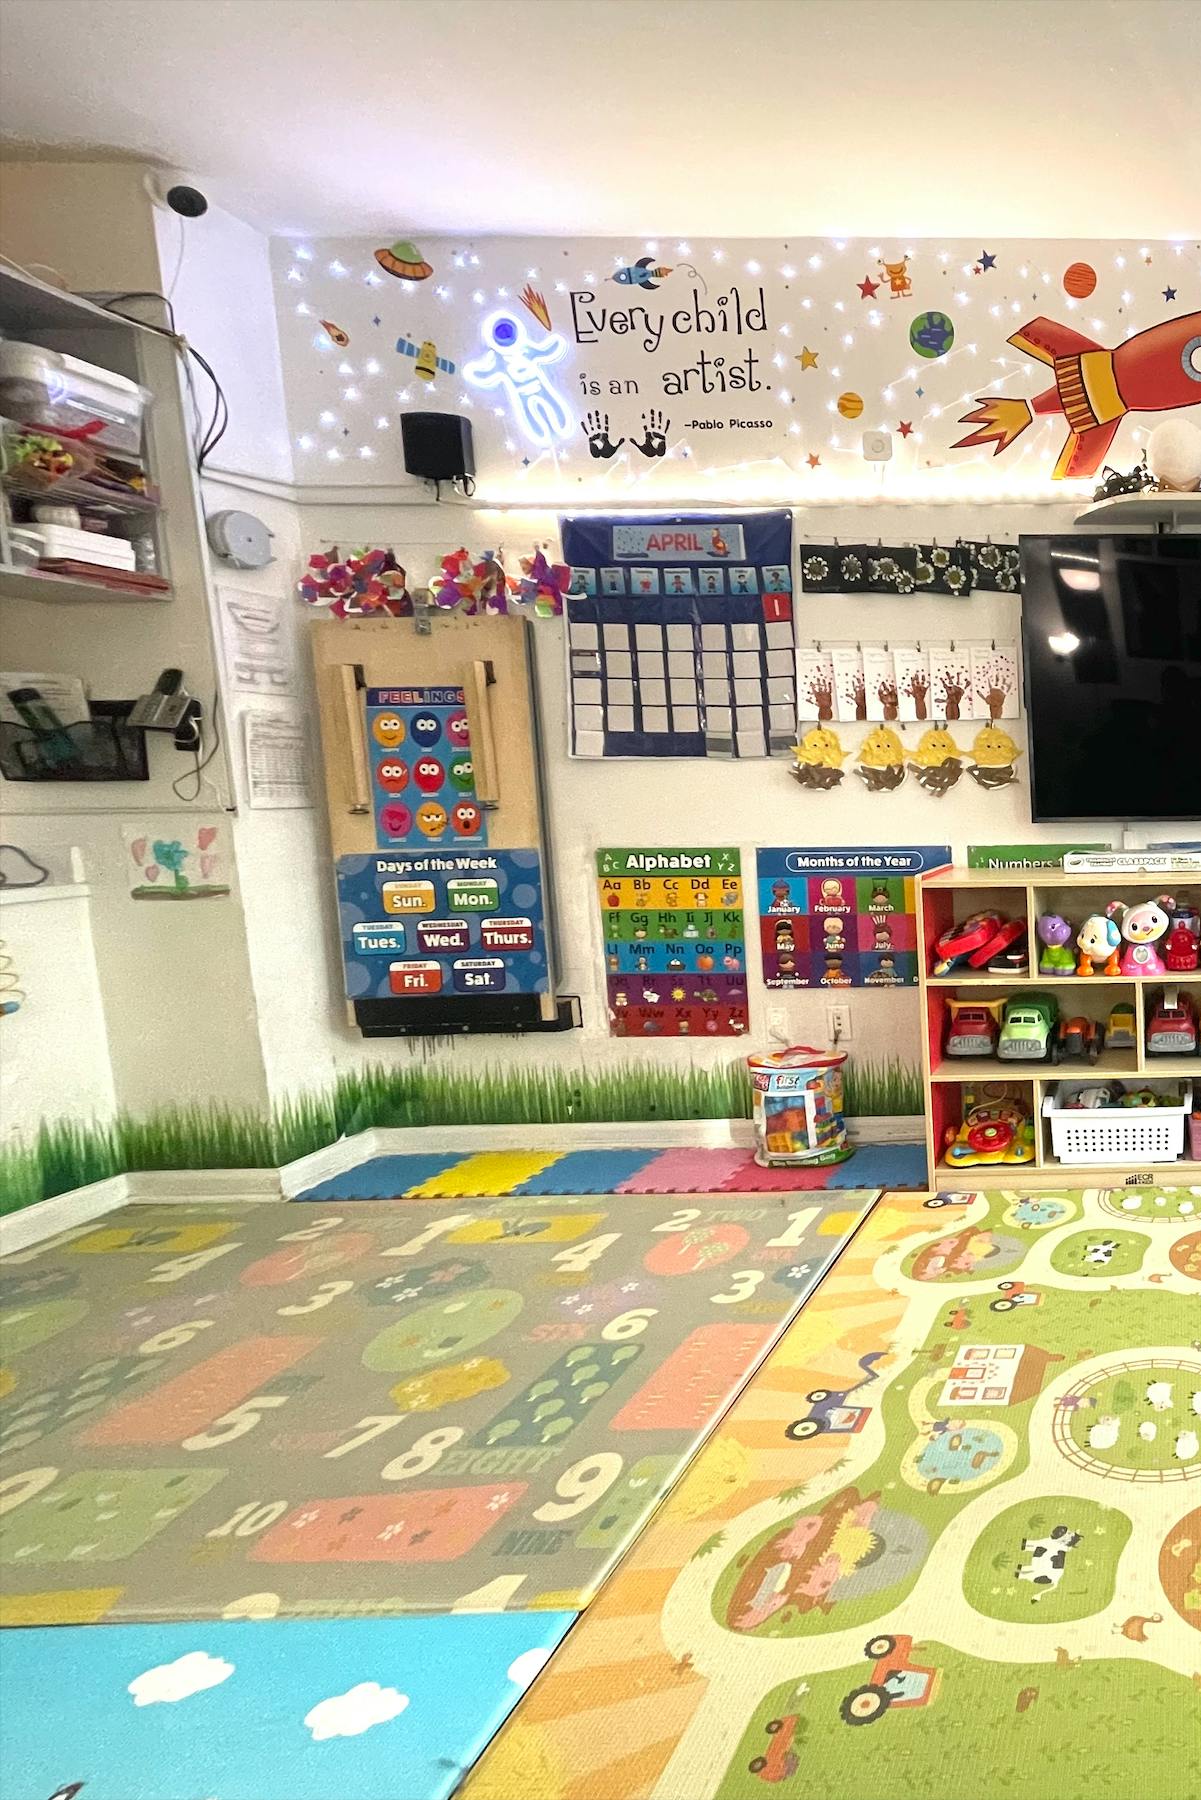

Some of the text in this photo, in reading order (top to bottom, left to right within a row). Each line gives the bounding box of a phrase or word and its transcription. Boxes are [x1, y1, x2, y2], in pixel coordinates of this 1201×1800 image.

[570, 287, 768, 352] Every child
[579, 348, 771, 396] is an artist.
[729, 419, 773, 429] Picasso
[646, 533, 704, 551] APRIL
[378, 690, 465, 704] FEELINGS
[604, 853, 612, 862] A
[626, 854, 712, 872] Alphabet
[722, 853, 729, 861] X
[797, 856, 912, 868] Months of the Year
[988, 857, 1053, 869] Numbers
[376, 857, 497, 874] Days of the Week
[612, 861, 620, 870] C
[603, 878, 738, 890] Aa Bb Cc Dd Ee
[392, 895, 427, 908] Sun.
[453, 893, 494, 906] Mon.
[767, 905, 801, 914] January
[814, 905, 851, 914] February
[608, 912, 621, 923] Ff
[630, 912, 649, 926] Gg
[658, 912, 677, 923] Hh
[703, 912, 713, 926] Jj
[723, 911, 741, 923] Kk
[358, 936, 401, 949] Tues.
[424, 933, 465, 947] Wed.
[483, 932, 532, 945] Thurs.
[629, 944, 655, 954] Mm
[666, 944, 685, 954] Nn
[695, 944, 714, 954] Oo
[725, 943, 742, 957] Pp
[777, 943, 795, 952] May
[825, 942, 845, 950] June
[874, 942, 891, 950] July
[404, 974, 428, 988] Fri.
[464, 973, 495, 986] Sat.
[726, 974, 744, 986] Uu
[766, 978, 810, 987] September
[864, 976, 905, 984] November
[675, 1007, 692, 1018] Xx
[702, 1007, 719, 1020] Yy
[729, 1007, 744, 1018] Zz
[651, 1208, 702, 1233] 2
[766, 1206, 824, 1248] 1
[276, 1217, 344, 1242] 2
[380, 1214, 472, 1257] 1
[549, 1232, 623, 1273] 4
[145, 1242, 245, 1284] 4
[710, 1270, 765, 1304] 3
[276, 1281, 354, 1316] 3
[601, 1308, 660, 1341] 6
[139, 1320, 216, 1354] 6
[182, 1396, 290, 1452] 5
[322, 1413, 408, 1459] 7
[381, 1427, 560, 1480] 8 EIGHT
[532, 1452, 624, 1523] 9
[205, 1500, 289, 1539] 10
